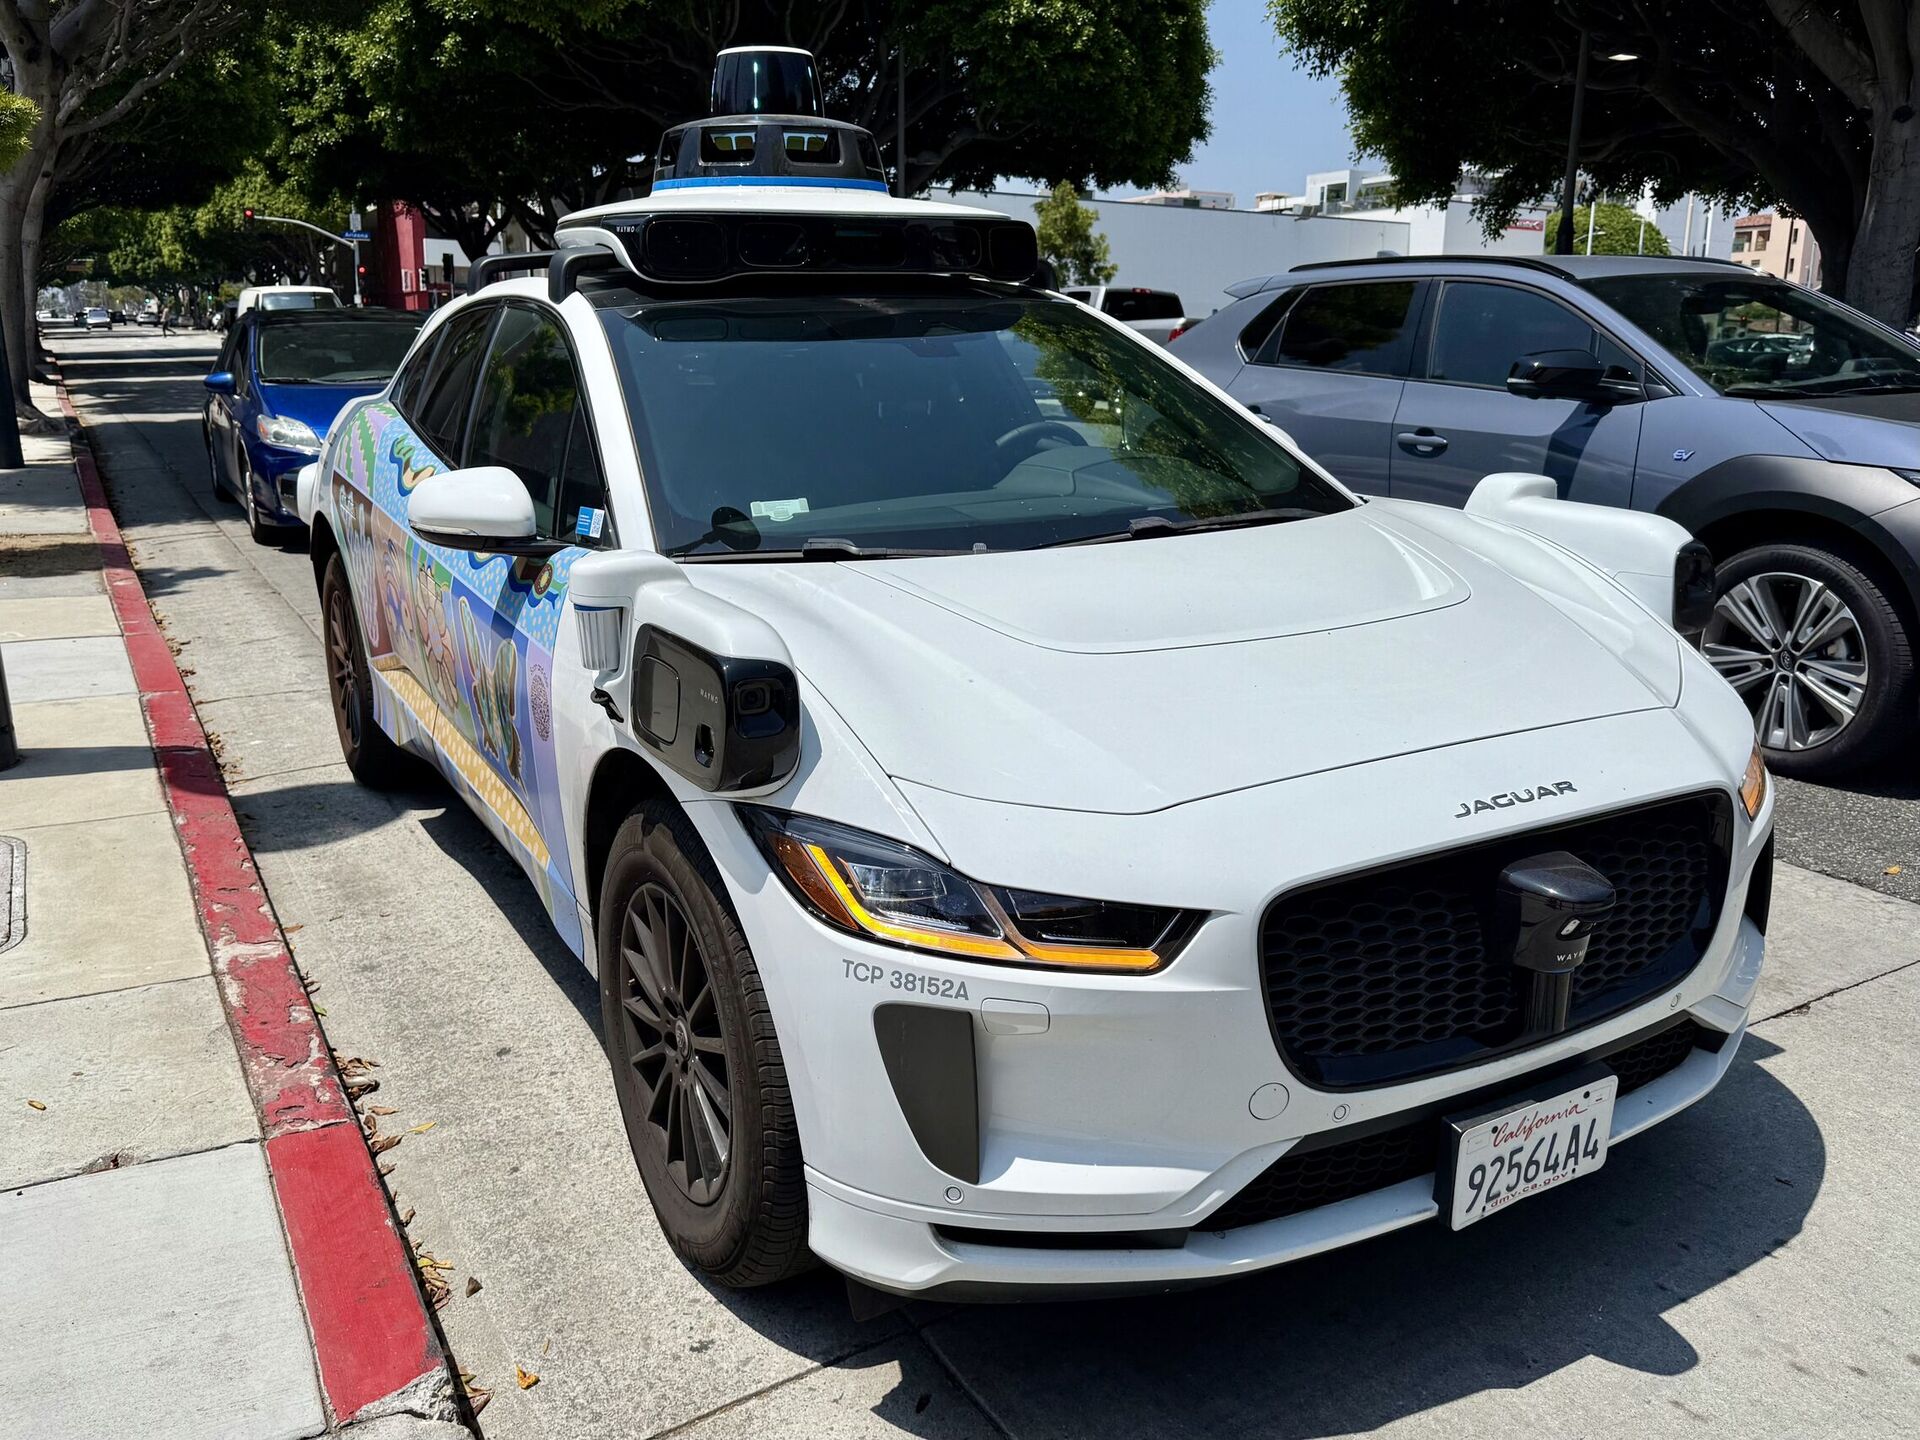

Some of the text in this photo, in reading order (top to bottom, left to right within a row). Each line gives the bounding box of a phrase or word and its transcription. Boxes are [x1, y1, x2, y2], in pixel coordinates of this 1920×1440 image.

[616, 225, 635, 233] WAYMO
[1673, 449, 1696, 461] EV
[700, 688, 719, 704] WAYMO
[1454, 780, 1578, 818] JAGUAR
[1556, 950, 1586, 961] WAYM
[842, 958, 969, 1001] TCP 38152A
[1493, 1101, 1588, 1148] California
[1465, 1118, 1599, 1214] 92564A4
[1490, 1171, 1569, 1208] dmv.ca.gov
